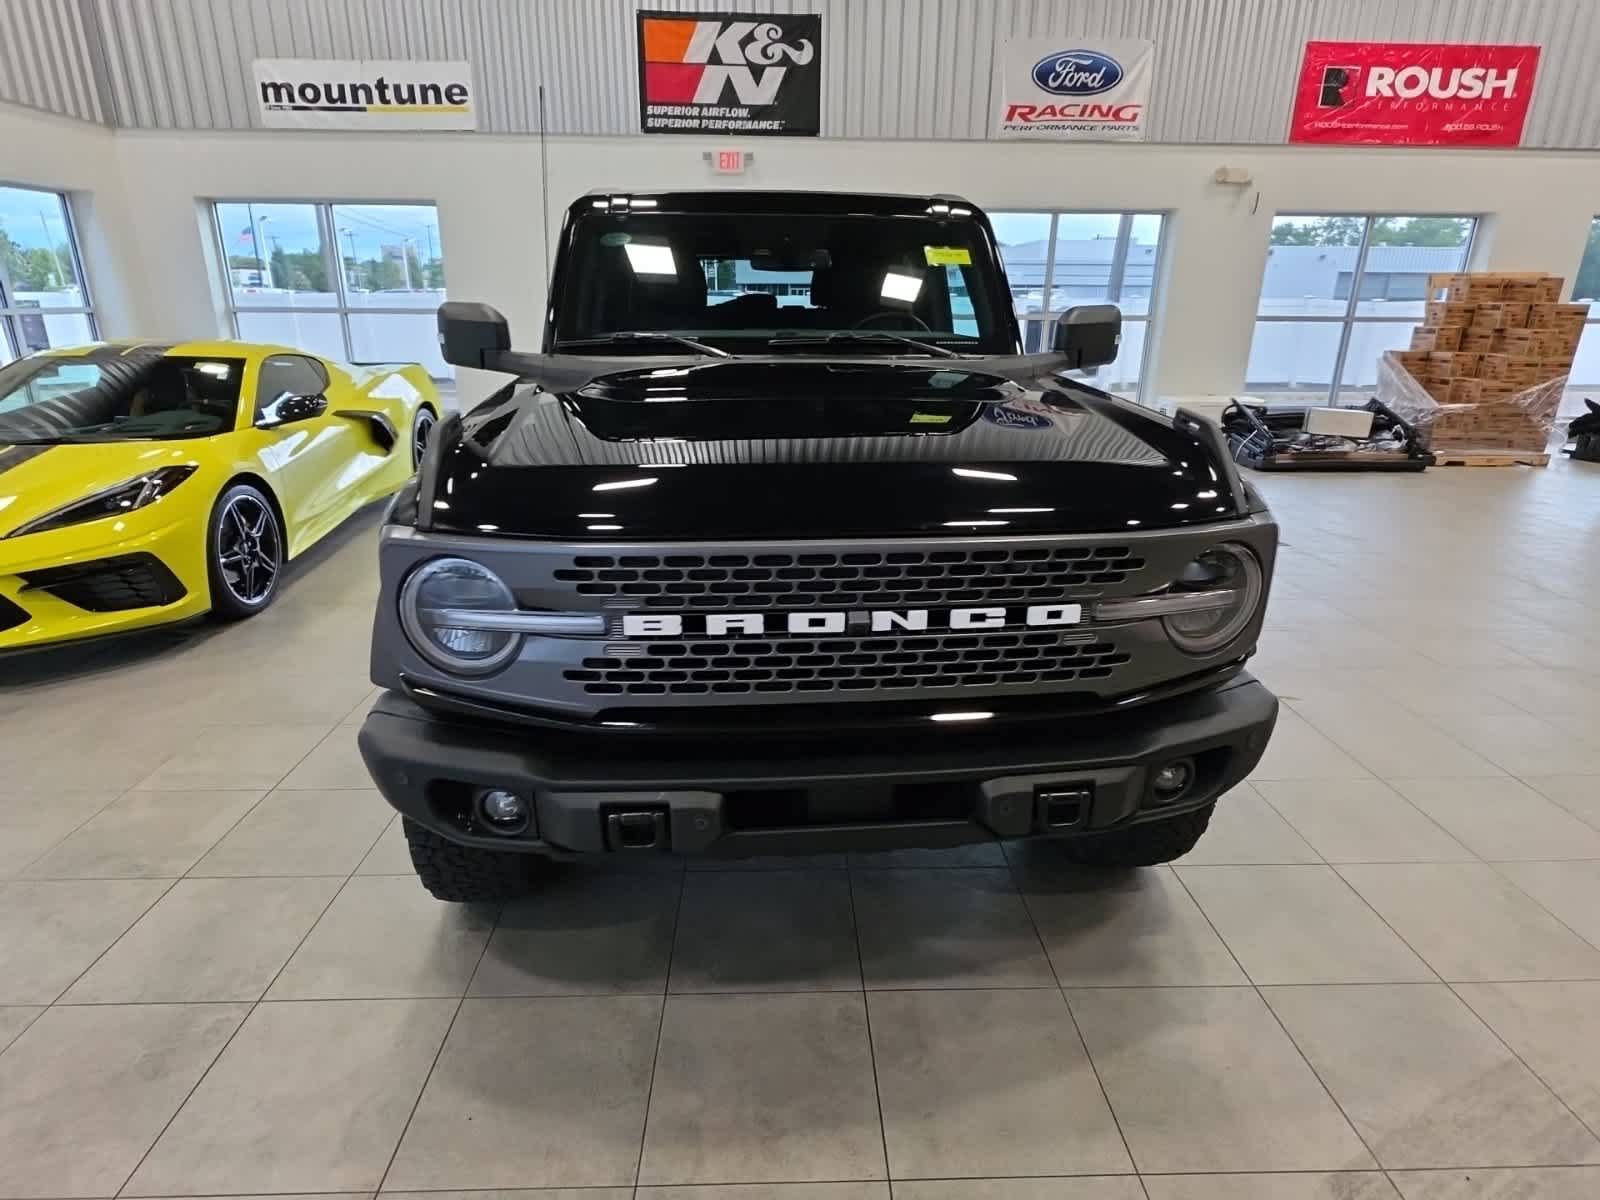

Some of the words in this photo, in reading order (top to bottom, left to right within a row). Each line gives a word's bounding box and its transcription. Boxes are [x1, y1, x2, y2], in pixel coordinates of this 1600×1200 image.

[1048, 57, 1106, 88] Ford
[261, 77, 469, 105] mountune
[1365, 66, 1519, 99] ROUSH
[647, 105, 699, 117] SUPERIOR
[701, 107, 751, 118] AIRFLOW.
[1005, 103, 1142, 122] RACING
[1363, 101, 1512, 112] ERFORMANCE
[647, 118, 699, 129] SUPERIOR
[1003, 124, 1098, 132] PERFORMANCE
[719, 151, 740, 169] EXIT
[623, 603, 1081, 636] BRONCO
